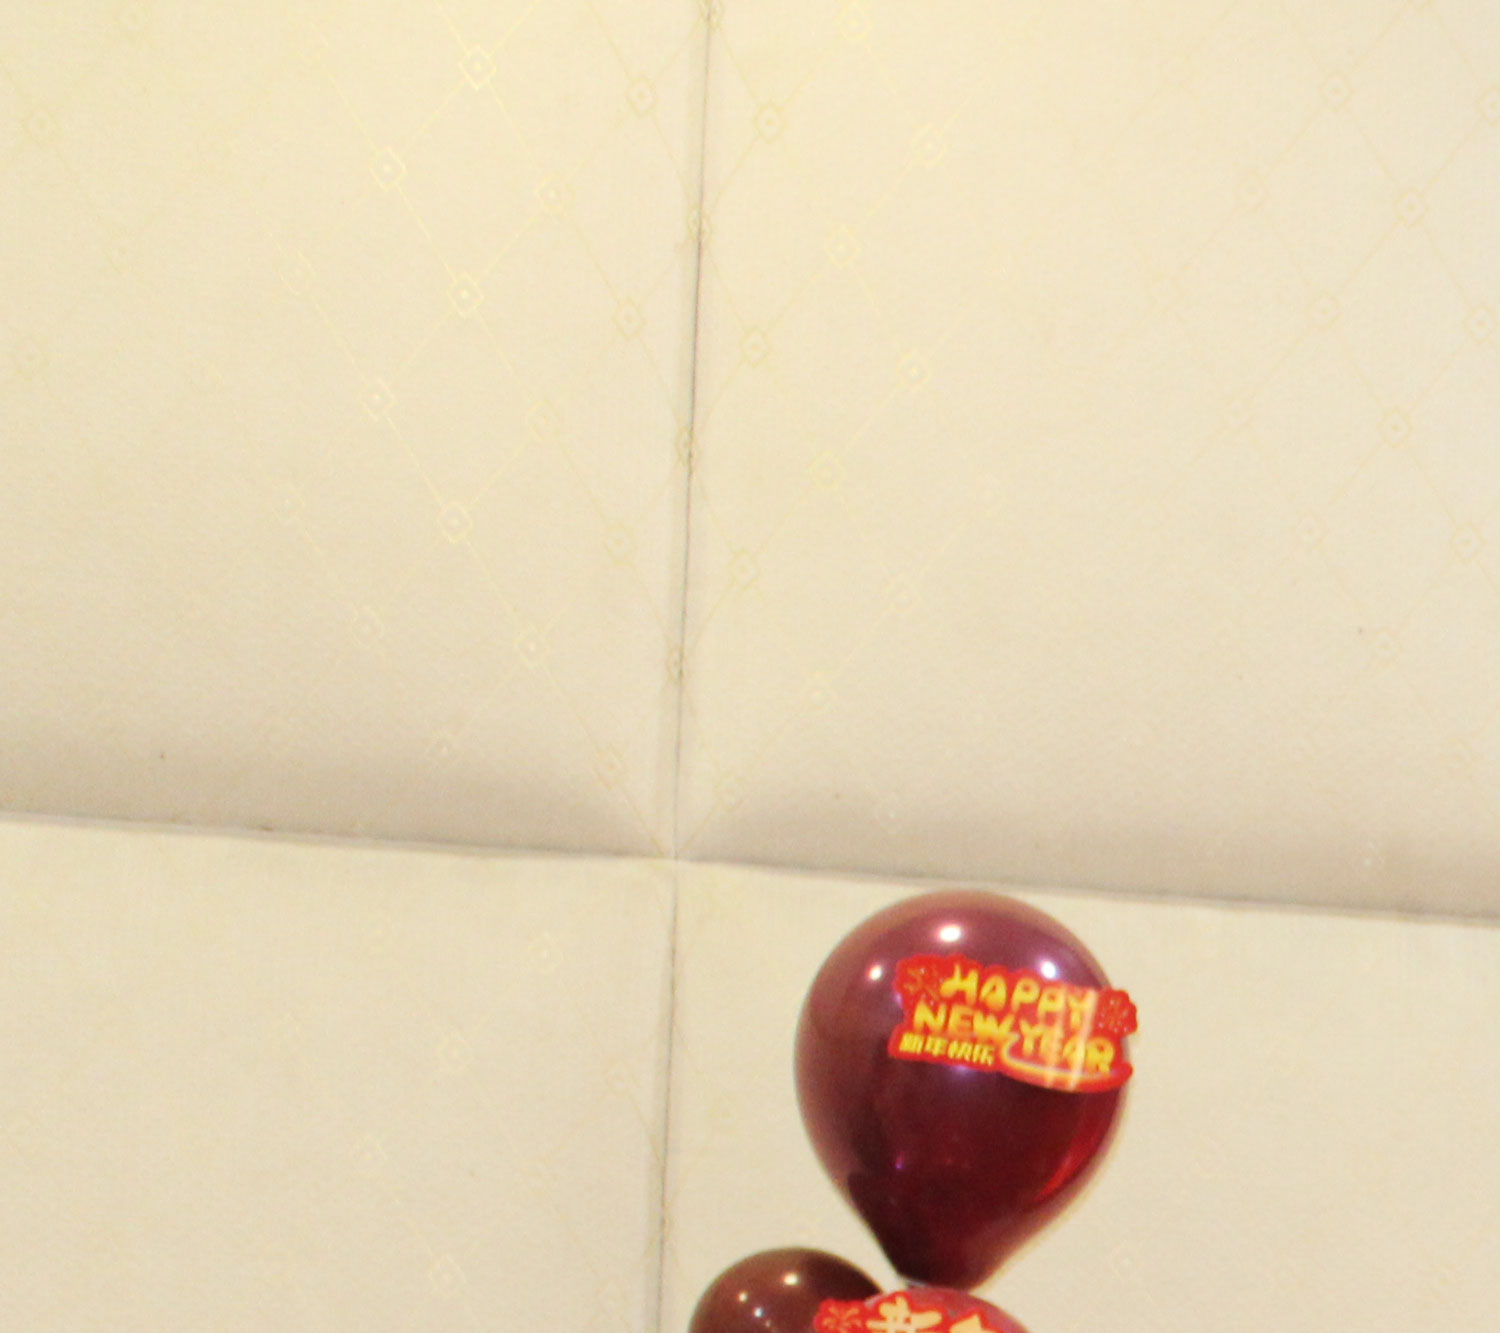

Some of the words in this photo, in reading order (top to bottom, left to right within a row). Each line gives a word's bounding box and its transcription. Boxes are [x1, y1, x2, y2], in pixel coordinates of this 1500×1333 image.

[940, 964, 1096, 1030] HAPPY
[914, 1000, 1015, 1042] NEW
[1020, 1018, 1114, 1076] YEAR
